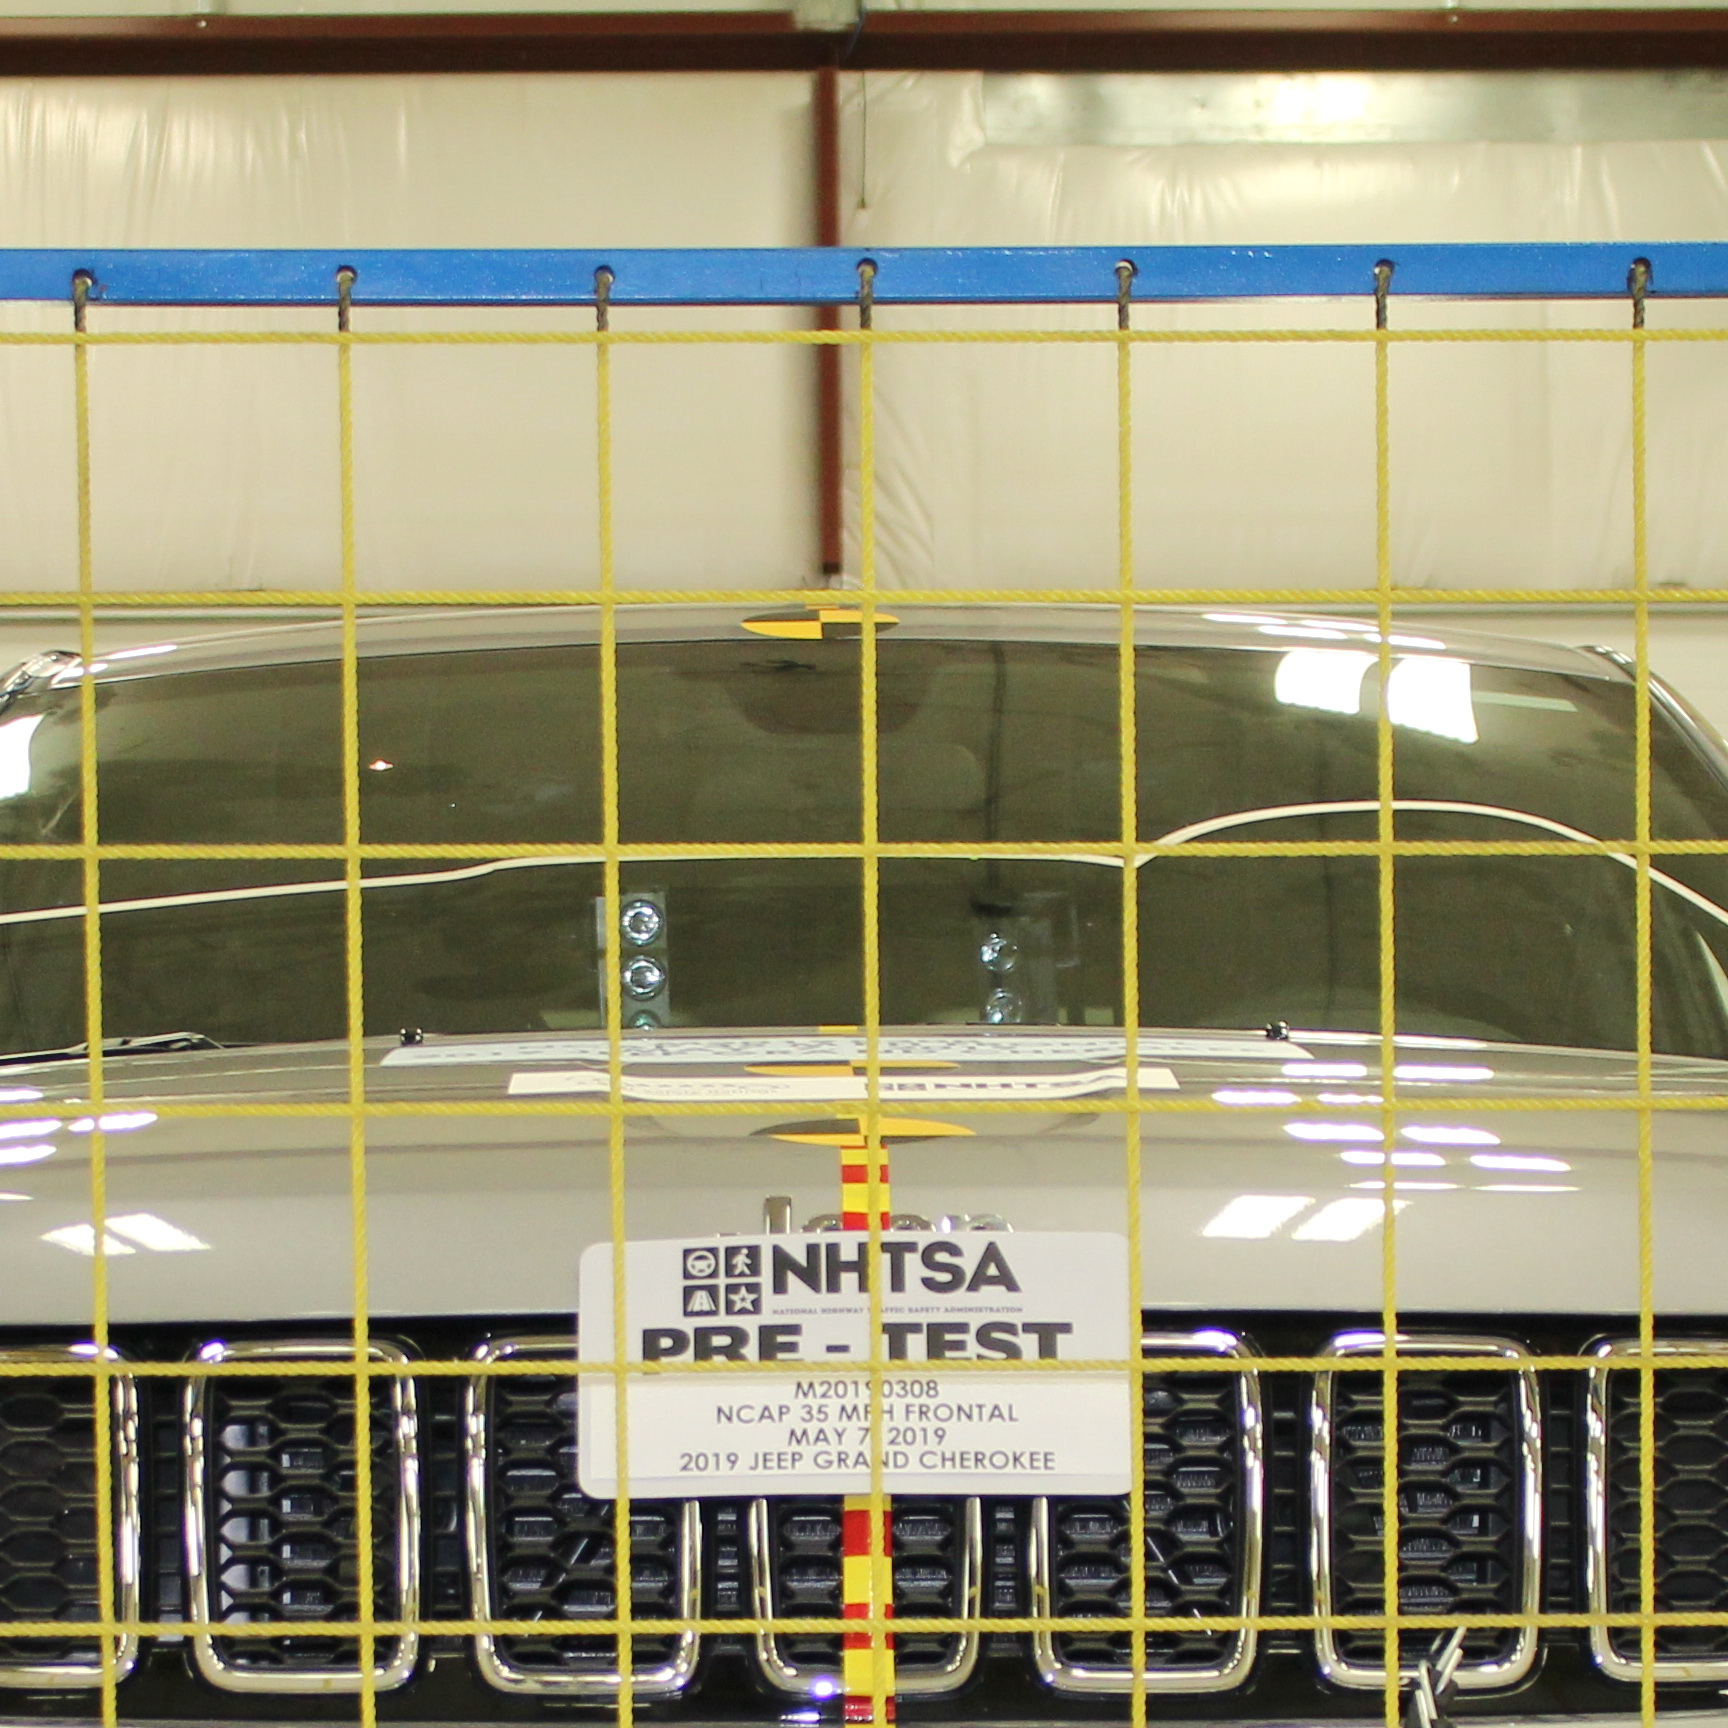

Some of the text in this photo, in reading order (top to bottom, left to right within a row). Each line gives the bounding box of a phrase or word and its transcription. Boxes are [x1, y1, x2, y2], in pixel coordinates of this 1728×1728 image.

[772, 1240, 1022, 1295] NHTSA
[642, 1324, 805, 1374] PRE
[881, 1321, 1073, 1369] TEST
[716, 1404, 792, 1424] NCAP
[800, 1403, 830, 1423] 35
[904, 1402, 1019, 1423] FRONTAL
[787, 1426, 848, 1447] MAY
[887, 1426, 947, 1446] 2019
[679, 1451, 740, 1472] 2019
[748, 1451, 804, 1471] JEEP
[918, 1450, 1057, 1471] CHEROKEE
